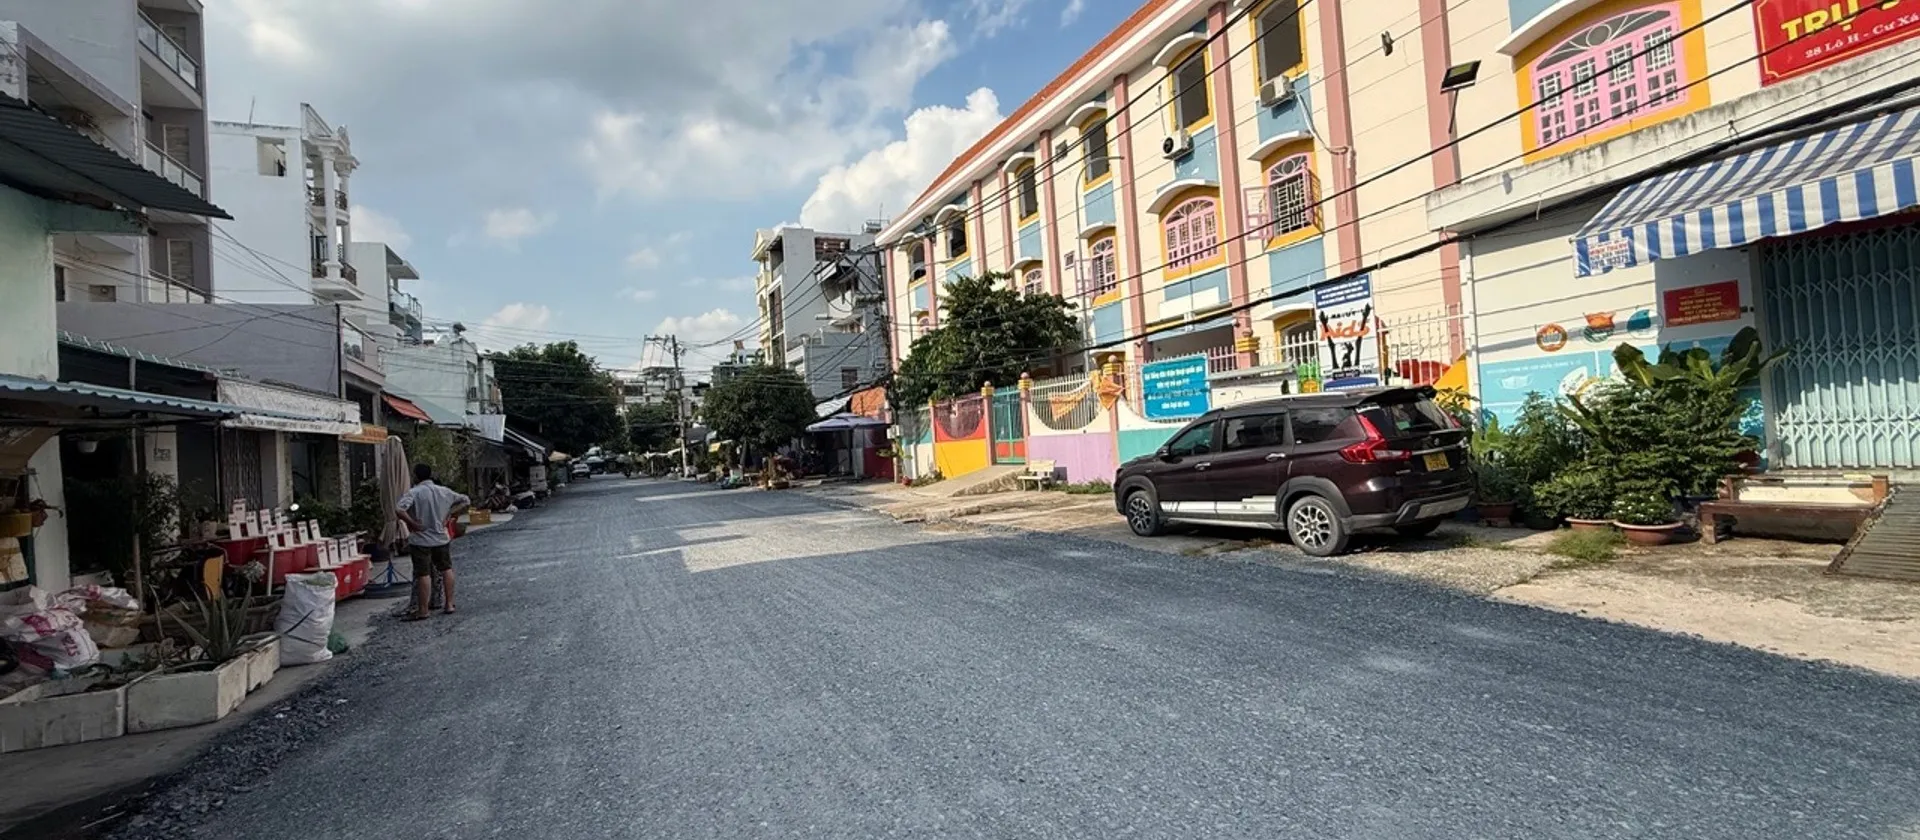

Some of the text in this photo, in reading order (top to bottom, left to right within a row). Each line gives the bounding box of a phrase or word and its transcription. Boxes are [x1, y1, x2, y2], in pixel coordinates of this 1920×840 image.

[1806, 47, 1822, 59] 28
[1825, 39, 1844, 52] Lô
[1847, 34, 1860, 44] H
